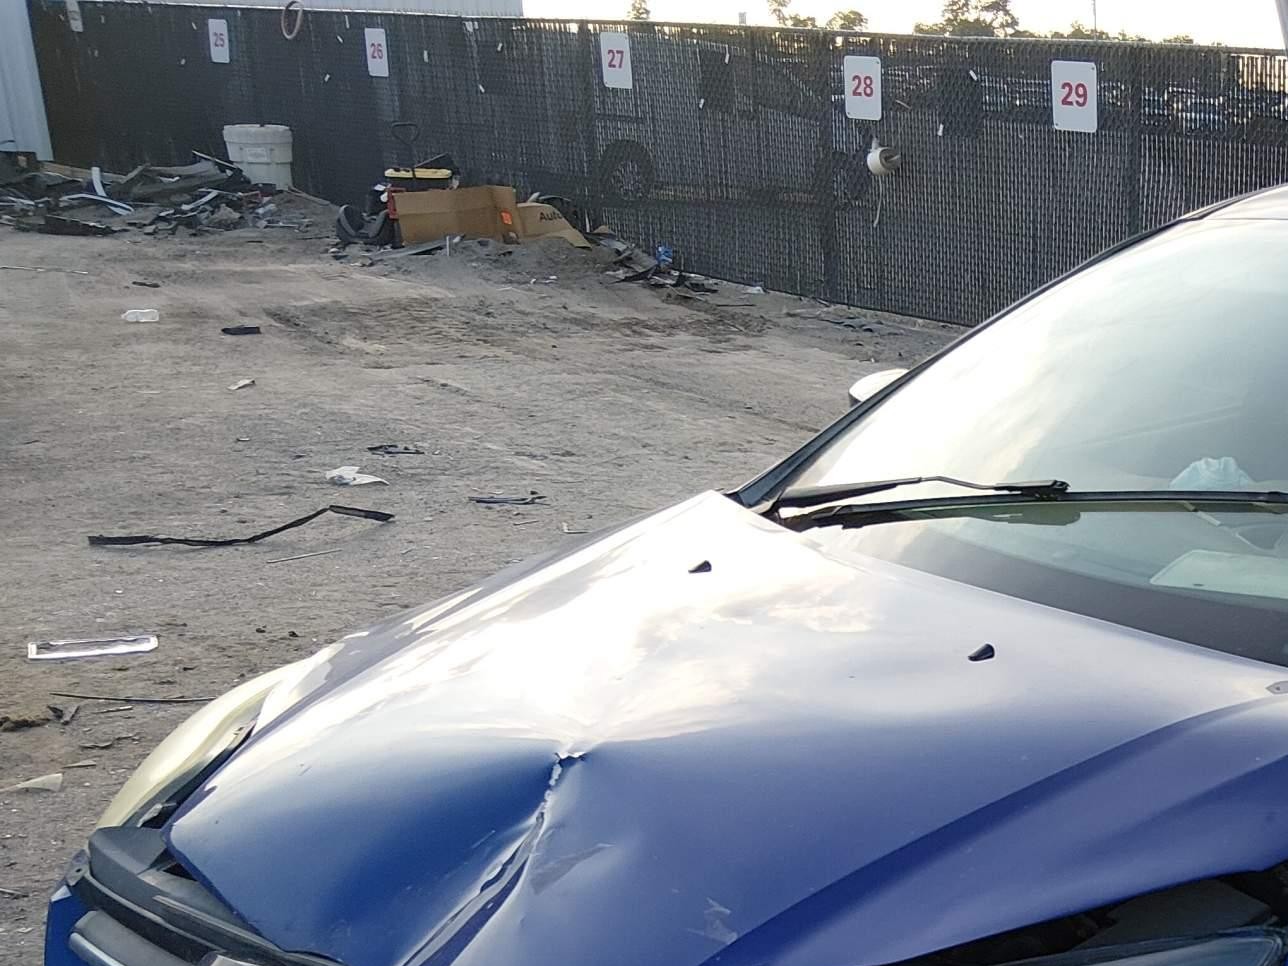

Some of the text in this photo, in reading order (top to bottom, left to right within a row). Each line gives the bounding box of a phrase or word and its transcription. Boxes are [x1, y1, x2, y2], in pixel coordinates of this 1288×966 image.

[213, 32, 225, 48] 25
[370, 42, 384, 60] 26
[607, 49, 625, 69] 27
[852, 74, 875, 98] 28
[1061, 82, 1088, 108] 29
